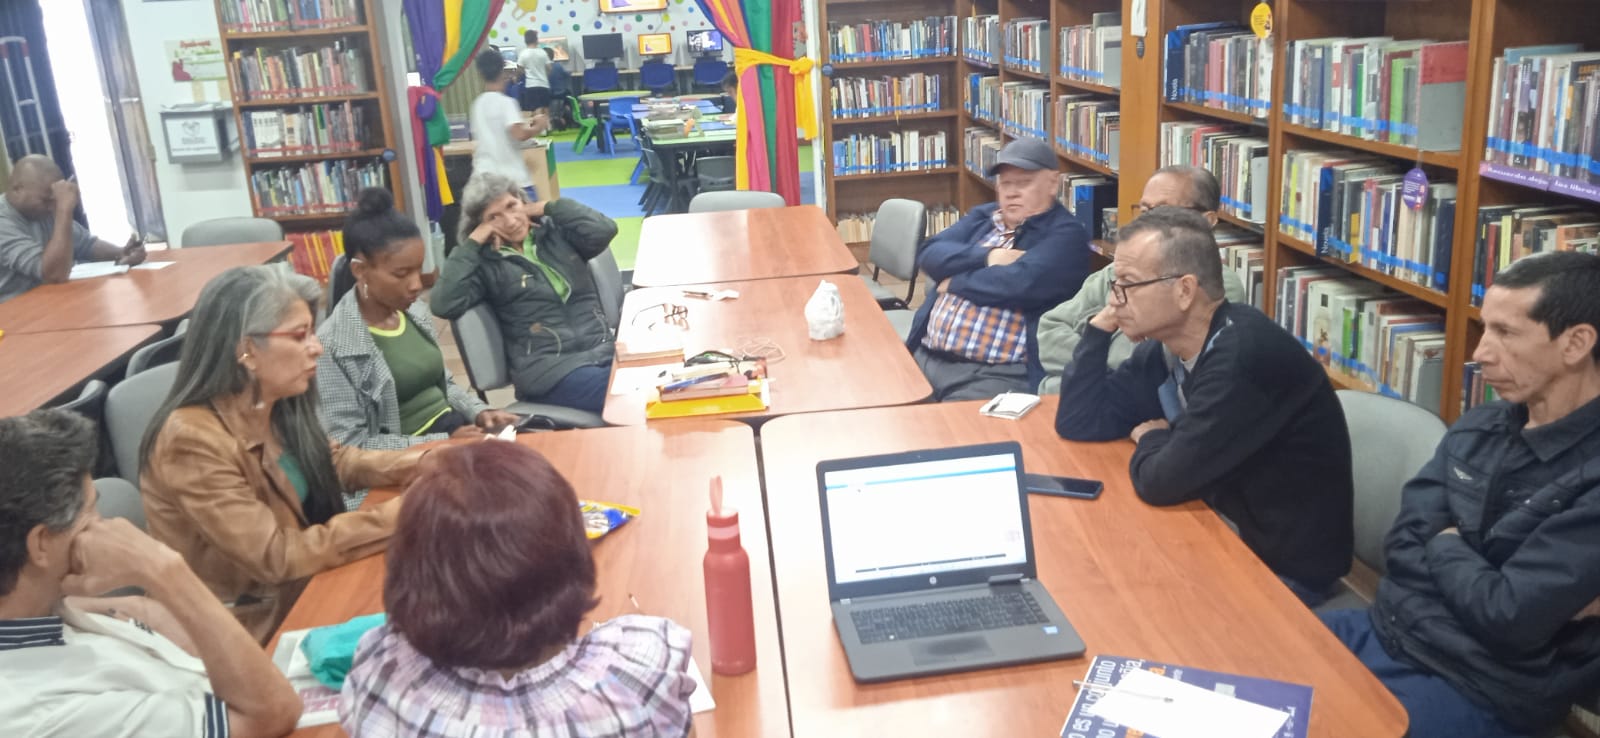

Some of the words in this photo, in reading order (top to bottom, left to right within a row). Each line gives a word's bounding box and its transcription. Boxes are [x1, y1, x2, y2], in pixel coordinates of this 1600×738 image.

[1488, 168, 1526, 180] Recuerda
[1570, 183, 1597, 196] libros
[1320, 226, 1329, 254] Novela
